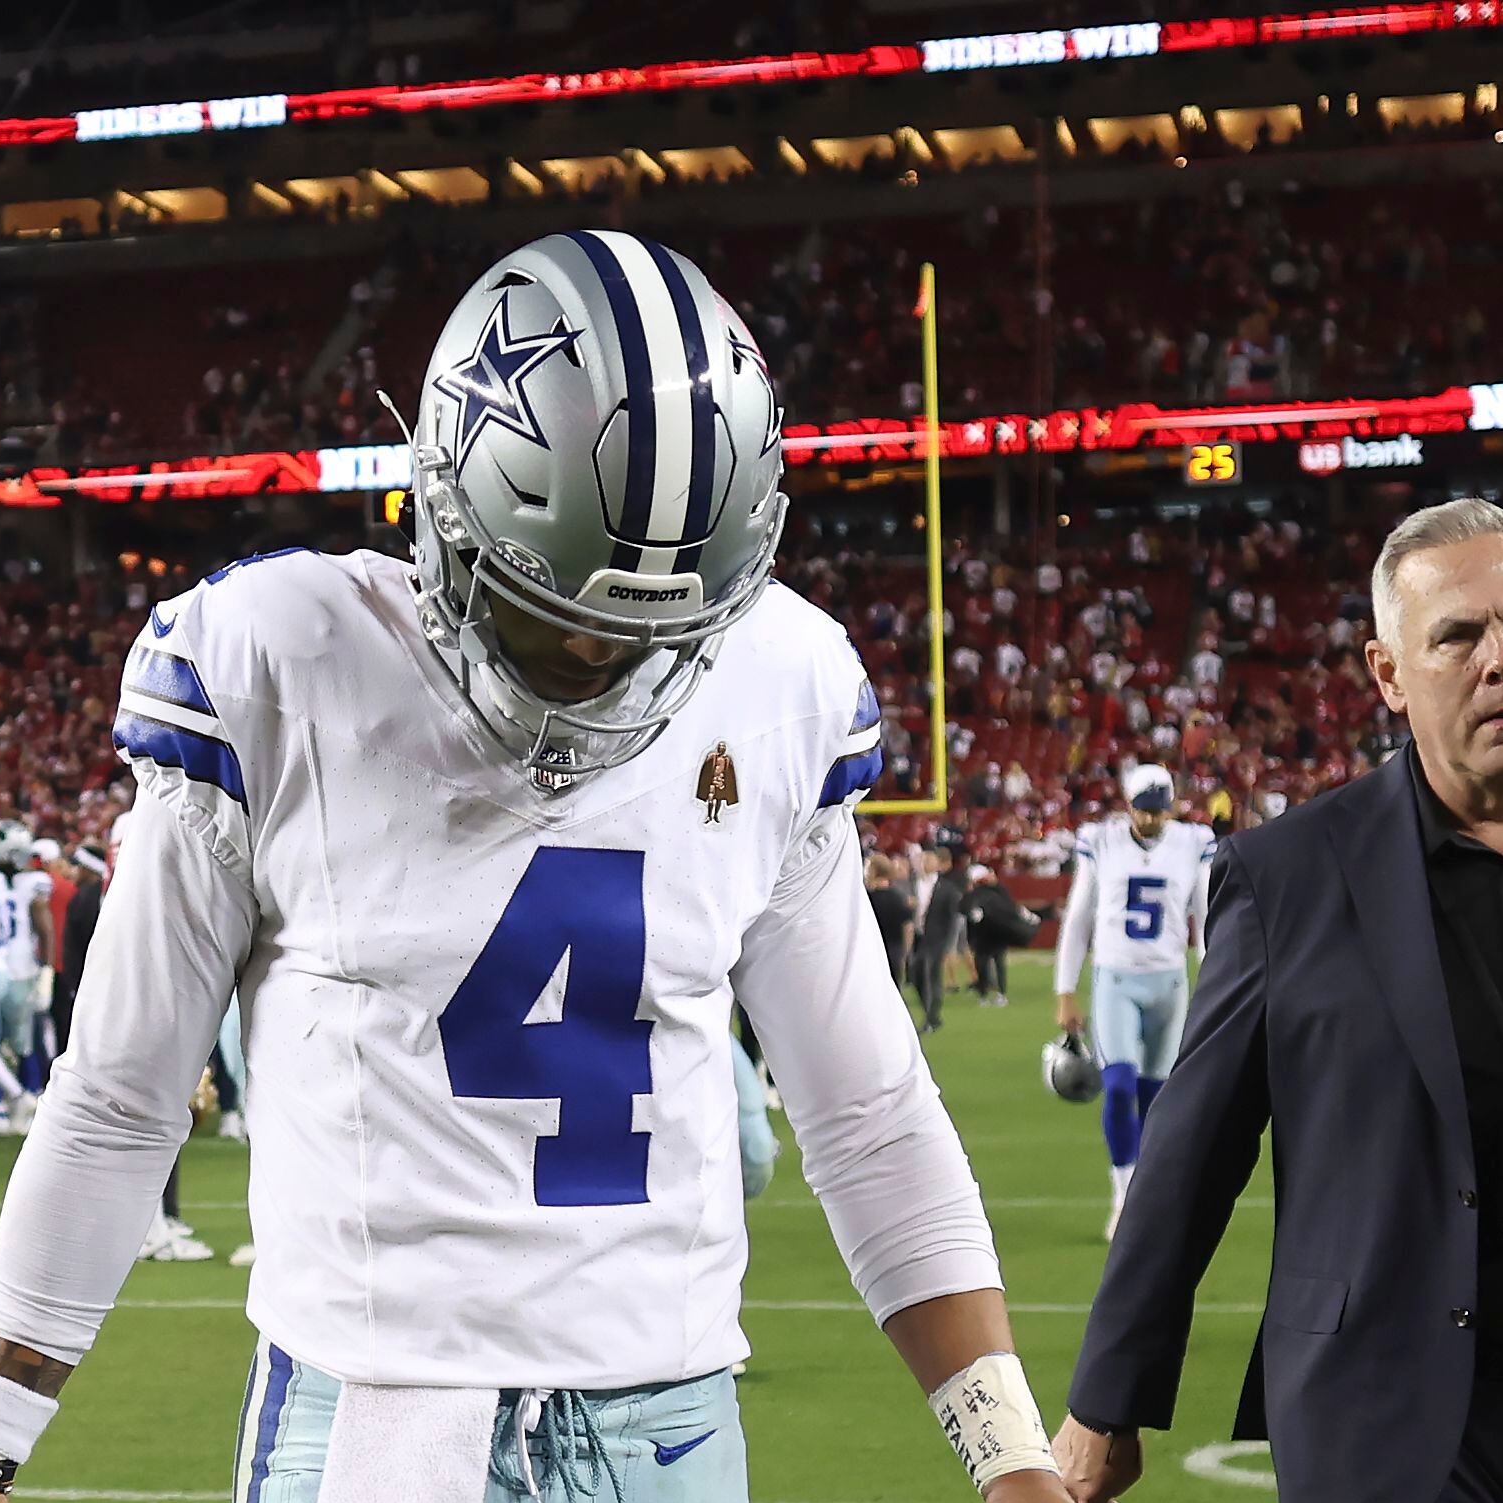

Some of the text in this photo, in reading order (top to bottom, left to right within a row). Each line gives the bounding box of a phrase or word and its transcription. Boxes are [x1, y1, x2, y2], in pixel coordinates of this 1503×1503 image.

[922, 22, 1161, 73] NINERS WIN
[208, 94, 287, 130] WIN
[1188, 445, 1235, 481] 25
[1343, 433, 1424, 469] bank
[496, 545, 547, 582] OAKLEY
[607, 584, 690, 602] COWBOYS
[1125, 875, 1168, 940] 5
[438, 845, 657, 1207] 4
